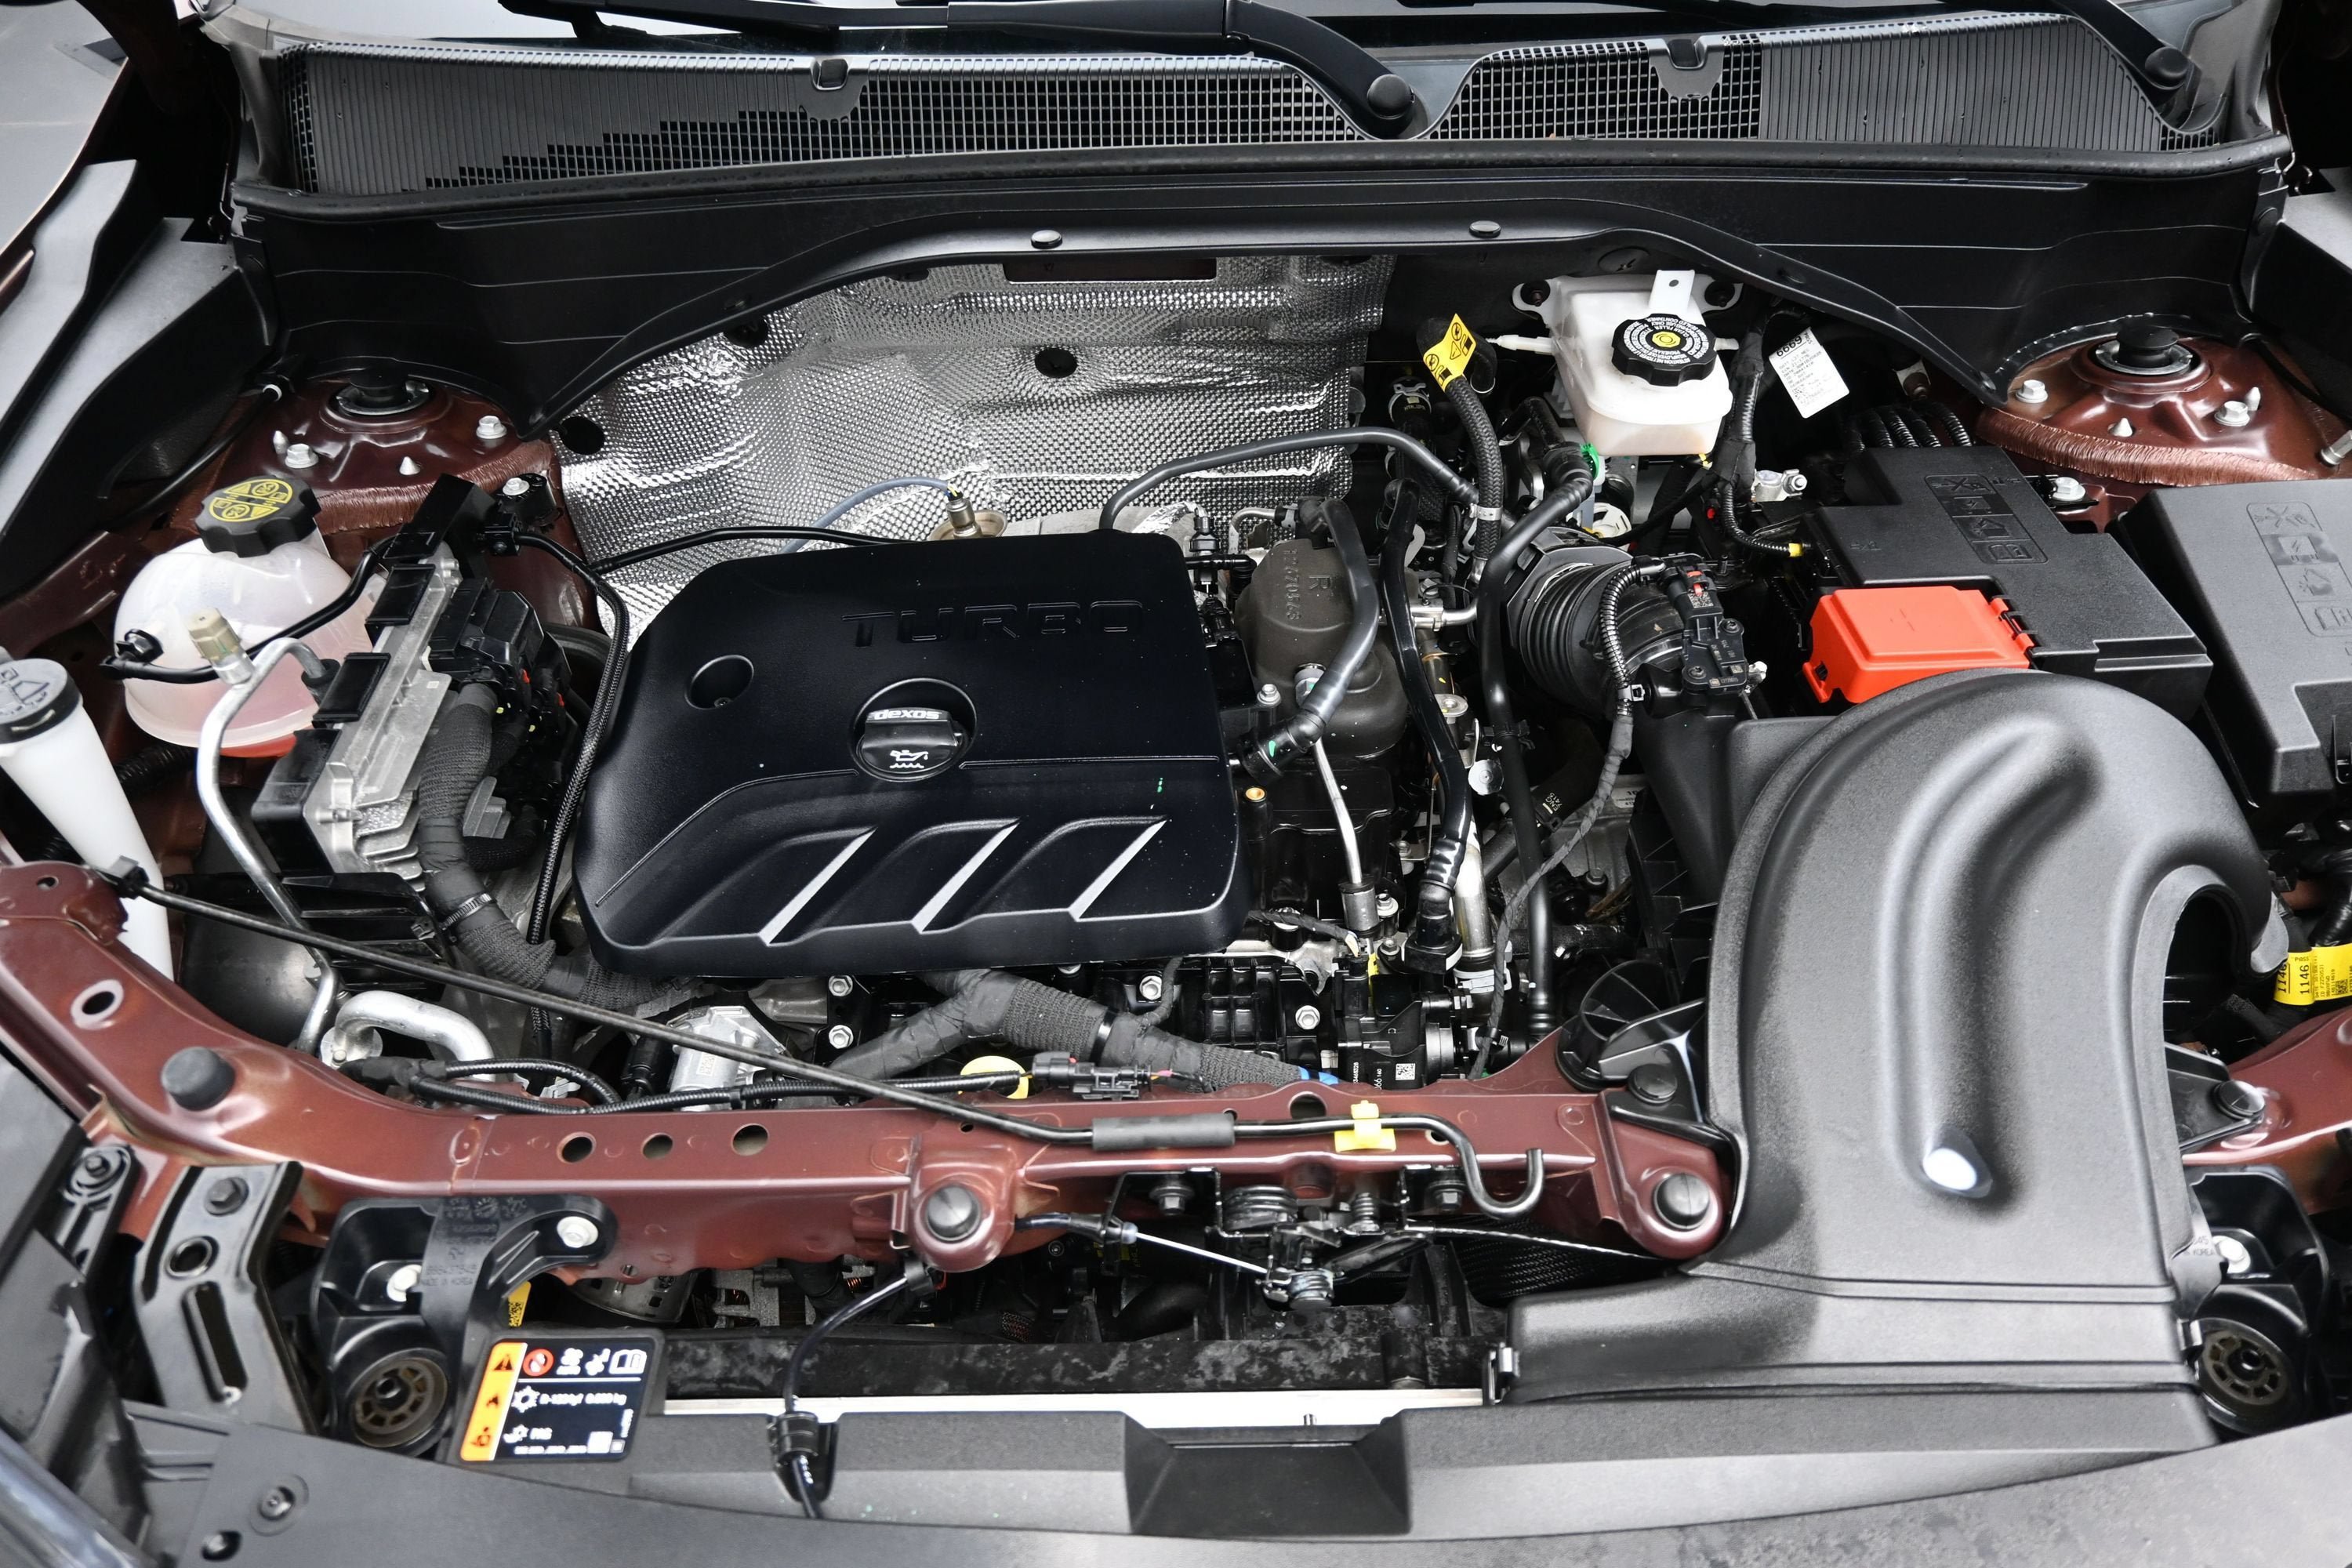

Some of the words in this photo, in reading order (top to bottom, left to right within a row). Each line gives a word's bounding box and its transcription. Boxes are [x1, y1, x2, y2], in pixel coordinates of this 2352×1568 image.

[1673, 327, 1690, 337] CLEAN
[841, 600, 1145, 647] TURBO
[873, 709, 942, 720] dexos
[1544, 796, 1559, 811] ENG
[2299, 964, 2310, 995] 1146
